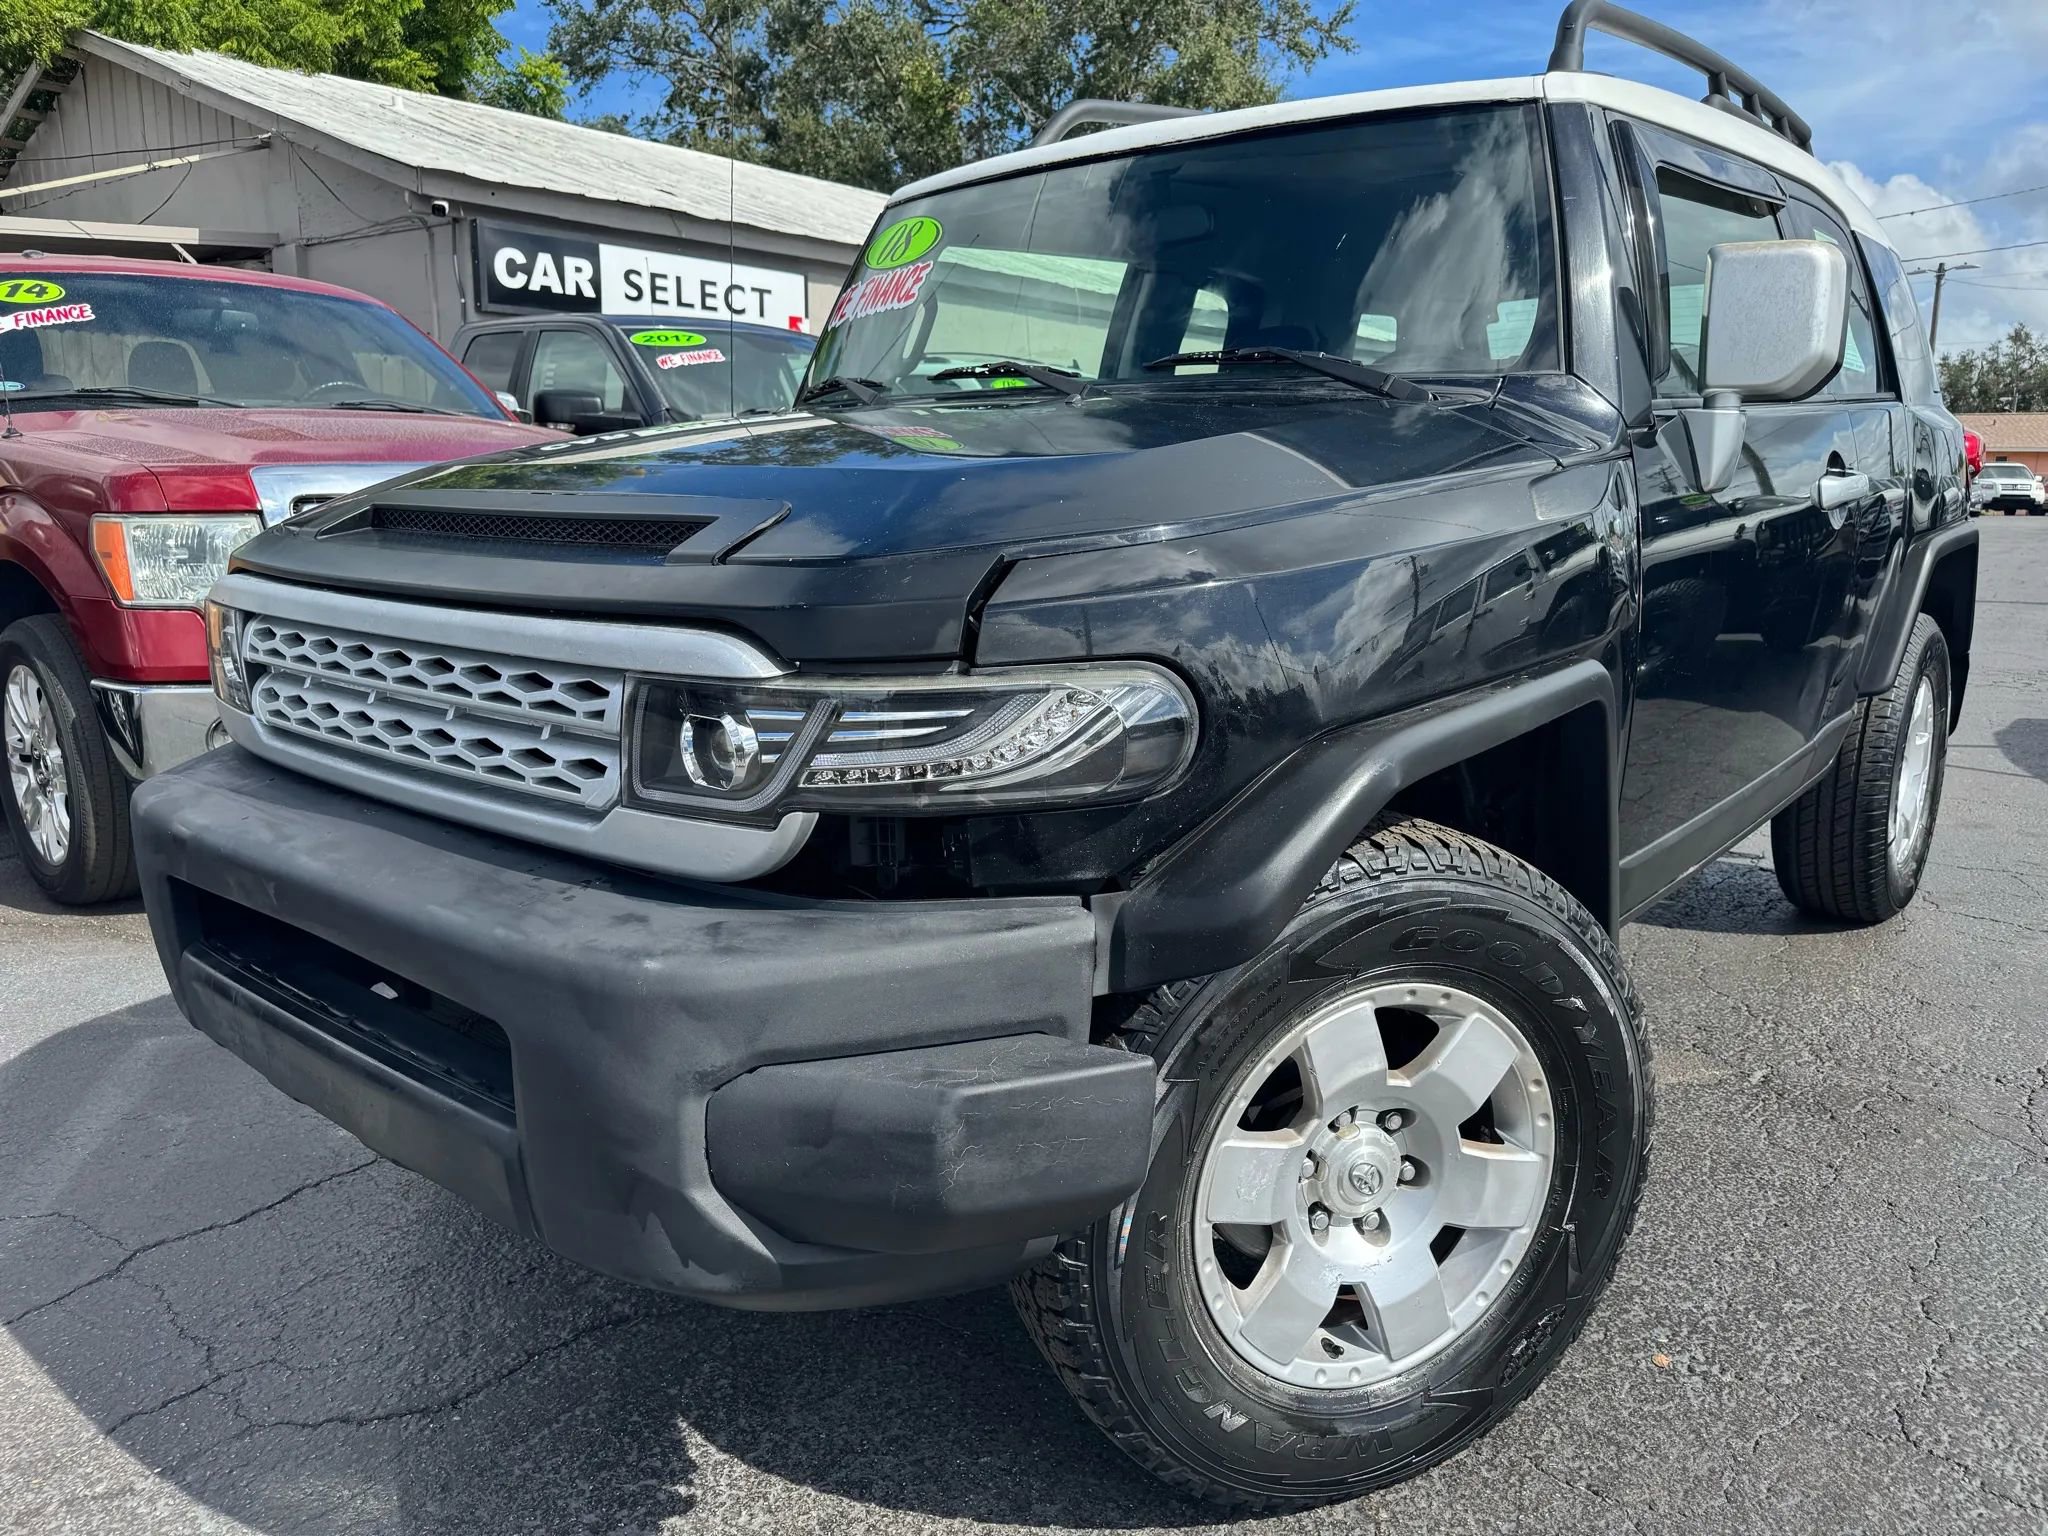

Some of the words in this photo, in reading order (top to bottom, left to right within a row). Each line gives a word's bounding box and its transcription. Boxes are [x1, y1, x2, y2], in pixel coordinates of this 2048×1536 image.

[876, 220, 925, 266] 08
[4, 283, 49, 299] 14
[493, 246, 597, 299] CAR
[623, 268, 773, 319] SELECT
[852, 263, 932, 320] FINANCE
[13, 305, 92, 328] FINANCE
[642, 334, 694, 344] 2017
[659, 355, 677, 368] WE
[679, 350, 721, 364] FINANCE
[1389, 926, 1617, 1200] GOODYEAR
[1144, 1209, 1395, 1461] WRANGLER
